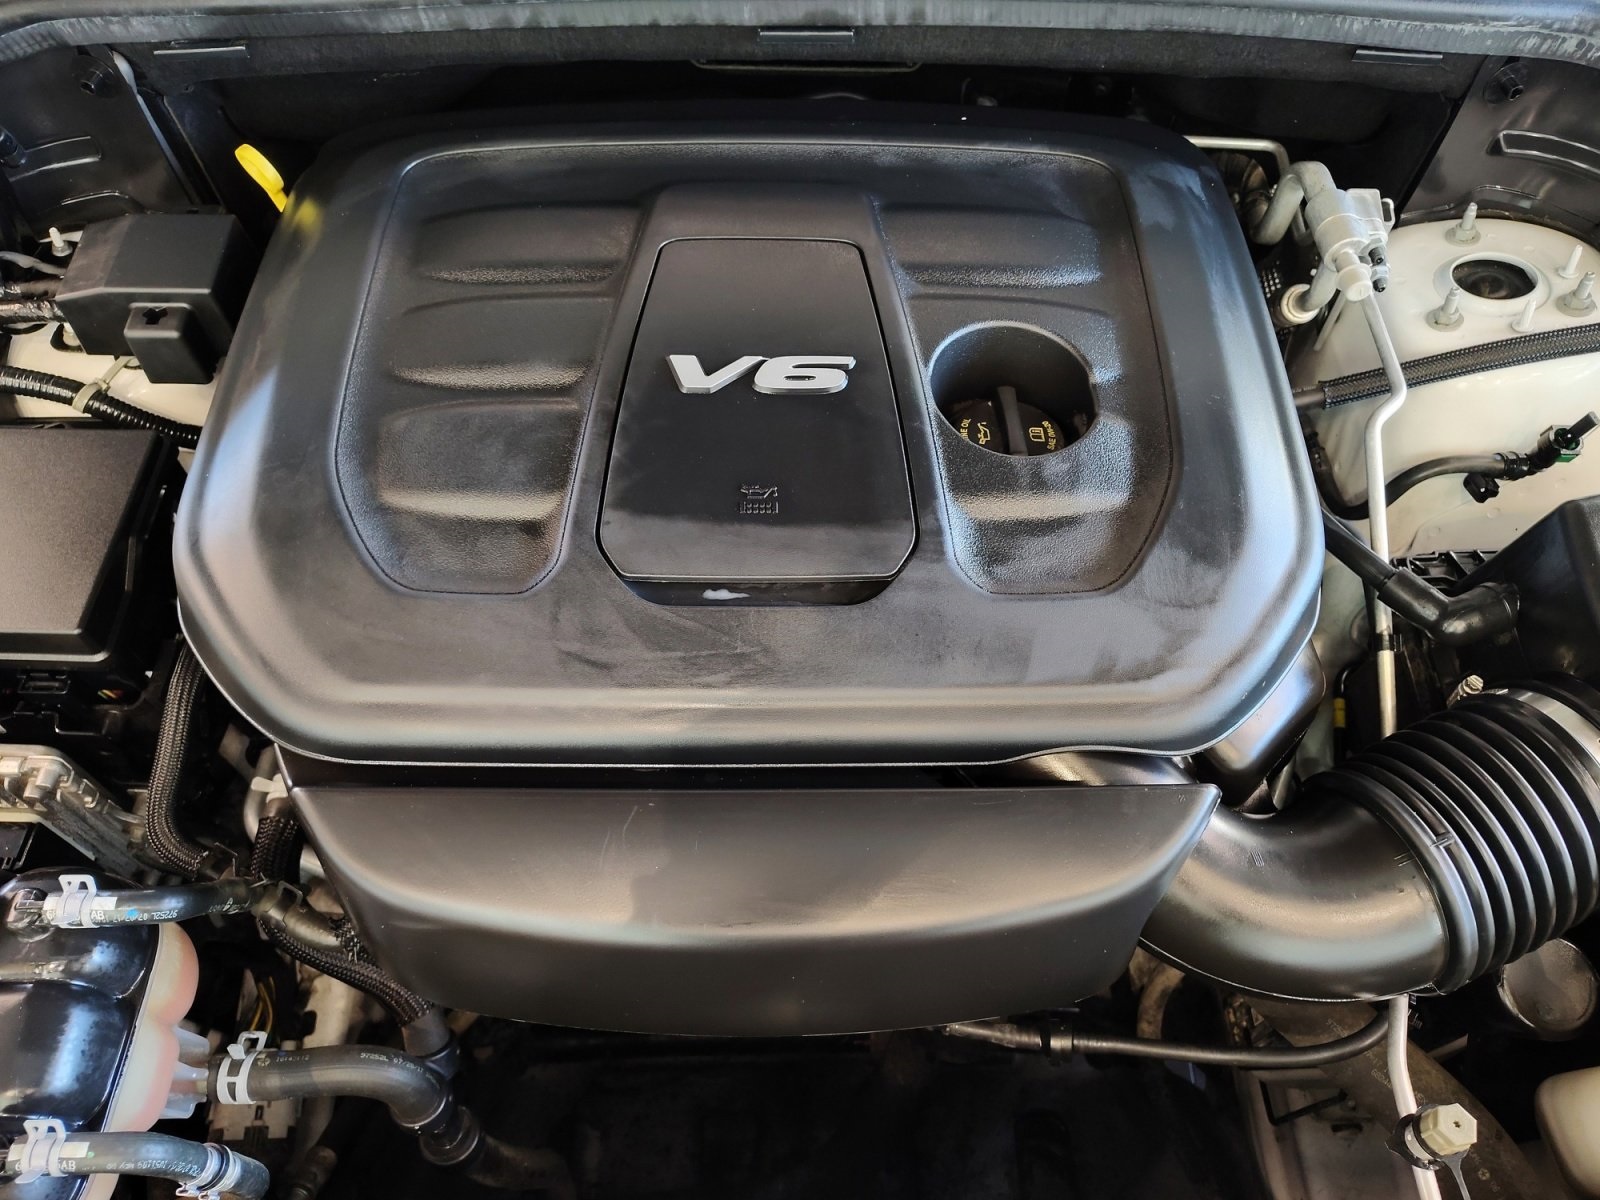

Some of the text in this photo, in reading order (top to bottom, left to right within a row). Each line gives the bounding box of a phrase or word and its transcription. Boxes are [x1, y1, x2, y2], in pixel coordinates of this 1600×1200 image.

[665, 354, 857, 395] V6
[1047, 438, 1057, 450] SAE
[151, 909, 178, 920] 97252L
